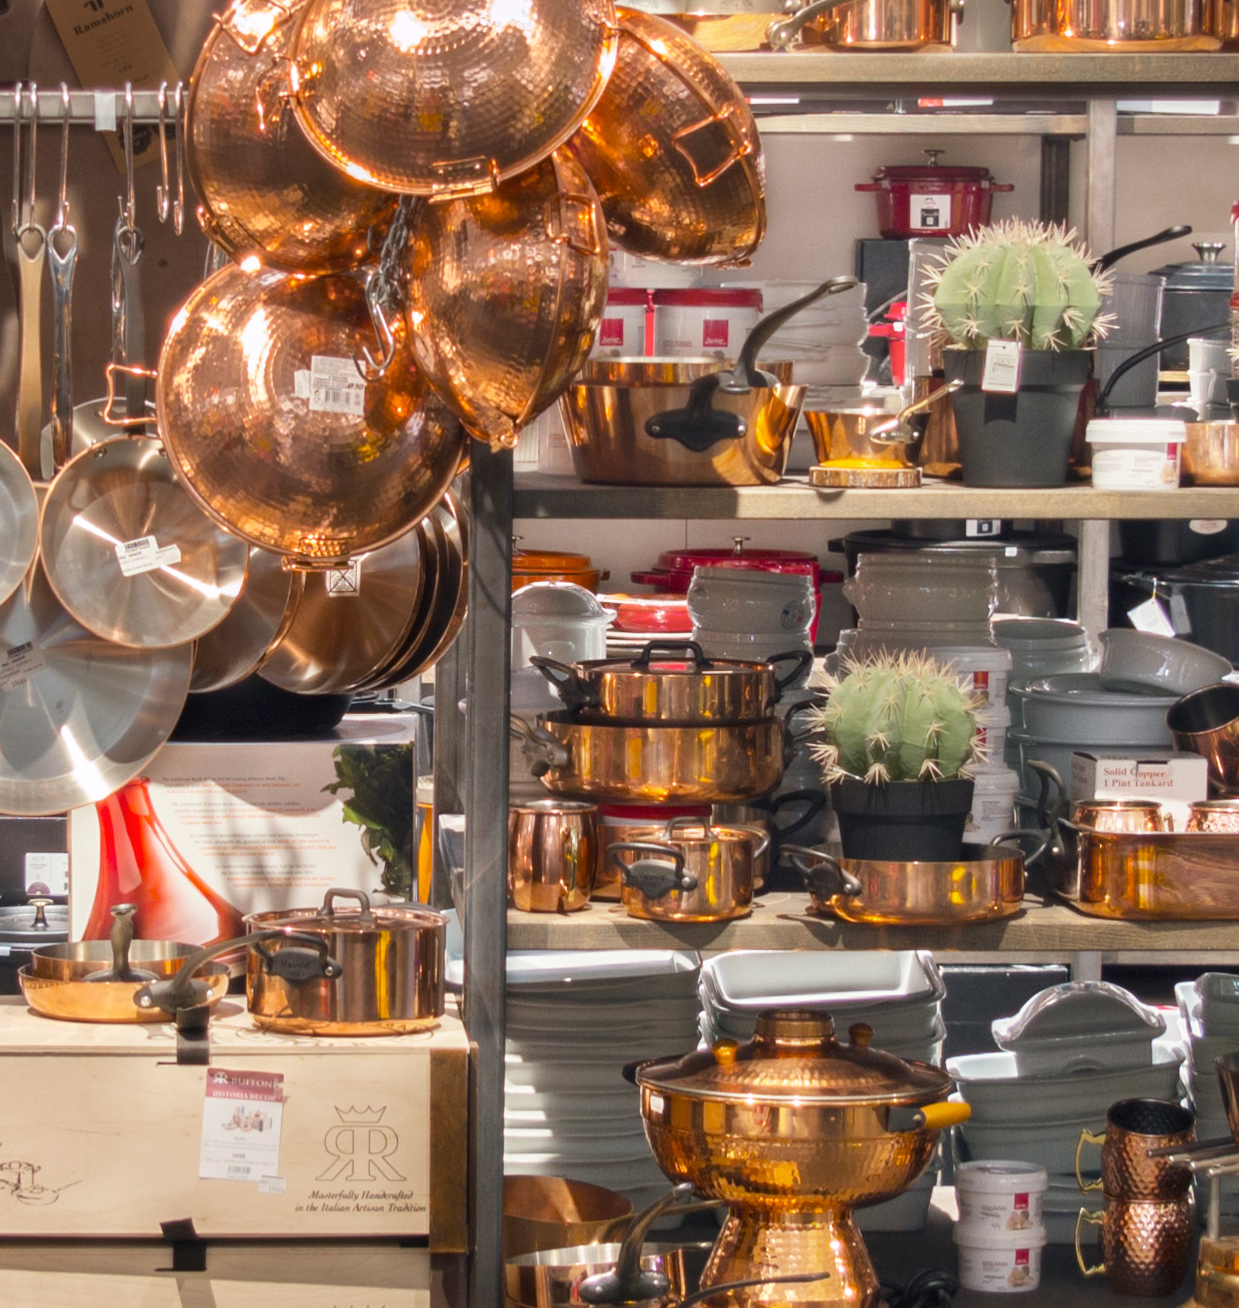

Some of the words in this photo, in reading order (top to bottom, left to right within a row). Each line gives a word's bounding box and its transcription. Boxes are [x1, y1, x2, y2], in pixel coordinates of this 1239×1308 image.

[73, 4, 134, 36] Ramshorn
[1103, 767, 1127, 776] Solid
[1111, 779, 1131, 787] Pint
[1135, 779, 1174, 787] Tankard
[309, 1190, 359, 1201] Masterfully
[361, 1190, 414, 1201] Handcrafted
[295, 1204, 303, 1212] in
[306, 1203, 319, 1212] the
[322, 1203, 350, 1212] Italian
[354, 1203, 385, 1212] Artisan
[388, 1202, 427, 1212] Tradition
